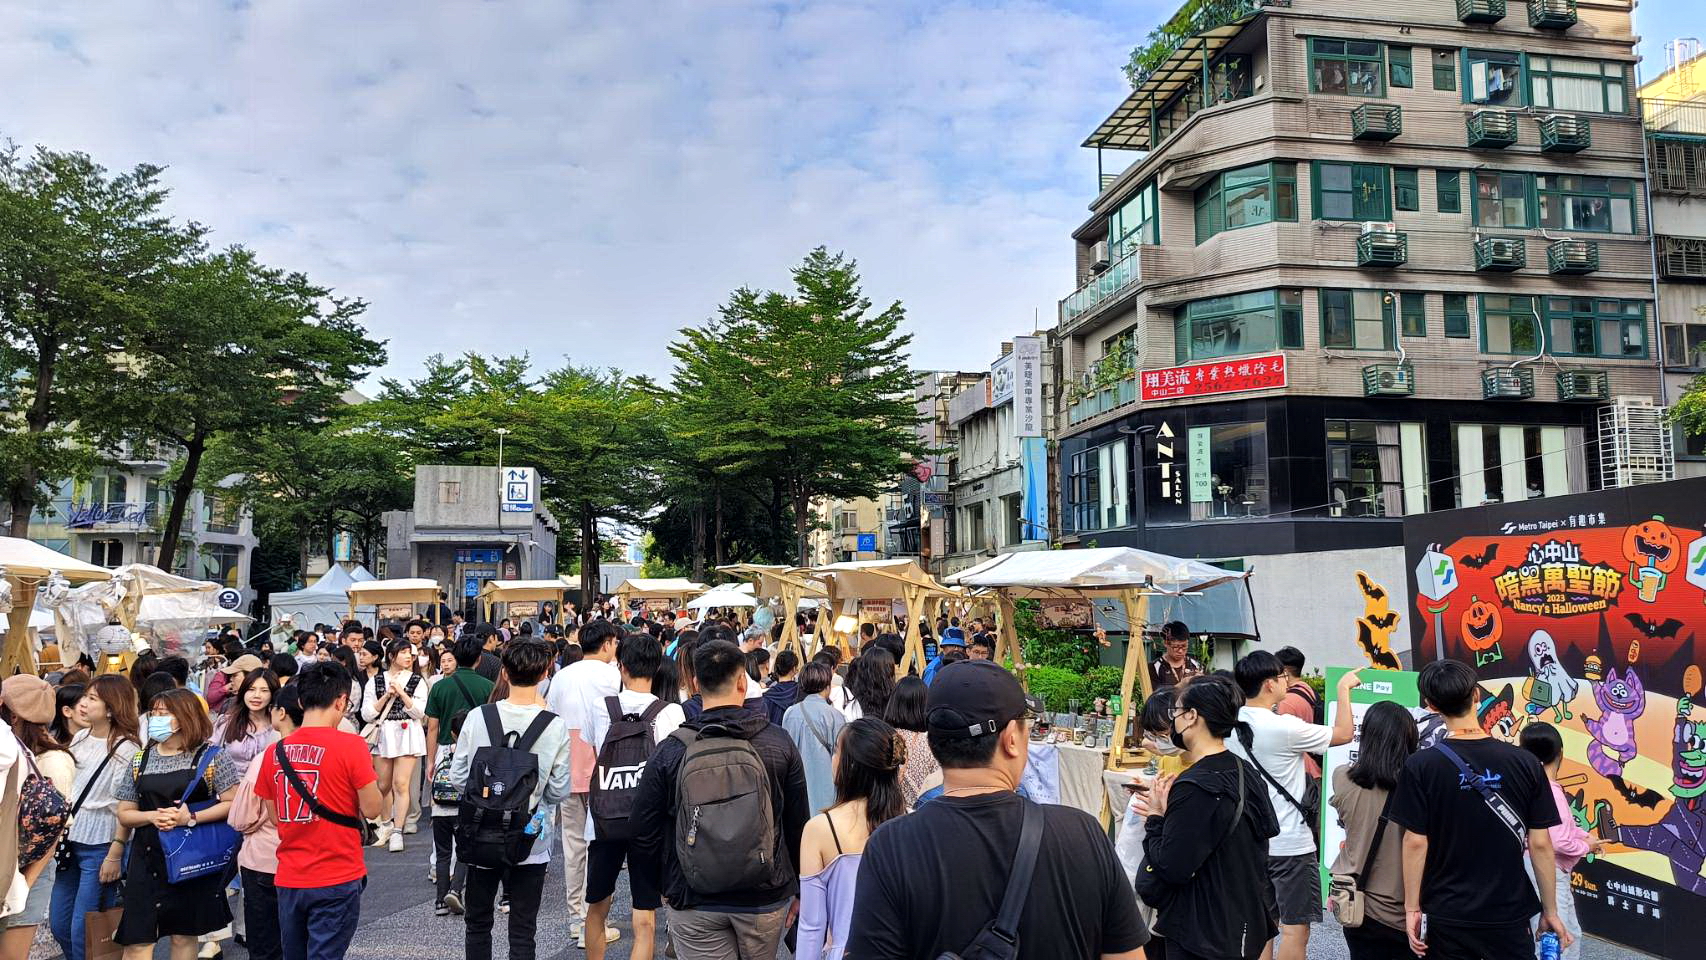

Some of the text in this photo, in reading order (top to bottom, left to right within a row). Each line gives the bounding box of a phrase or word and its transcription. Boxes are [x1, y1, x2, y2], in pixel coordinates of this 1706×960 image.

[1144, 370, 1190, 388] 翔美流
[1150, 386, 1185, 397] 中山二店
[1156, 421, 1175, 498] ANTI
[1174, 471, 1183, 504] SALON
[1518, 522, 1538, 532] Metro
[1539, 519, 1559, 530] Taipei
[1568, 512, 1606, 528] 有趣市集
[1528, 540, 1579, 564] 心中山
[1494, 561, 1622, 603] 暗黑萬聖節
[1512, 599, 1607, 616] Nancy's Halloween
[1546, 594, 1566, 602] 2023
[1375, 684, 1391, 692] Pay
[274, 770, 319, 822] 17
[1571, 871, 1583, 887] 29
